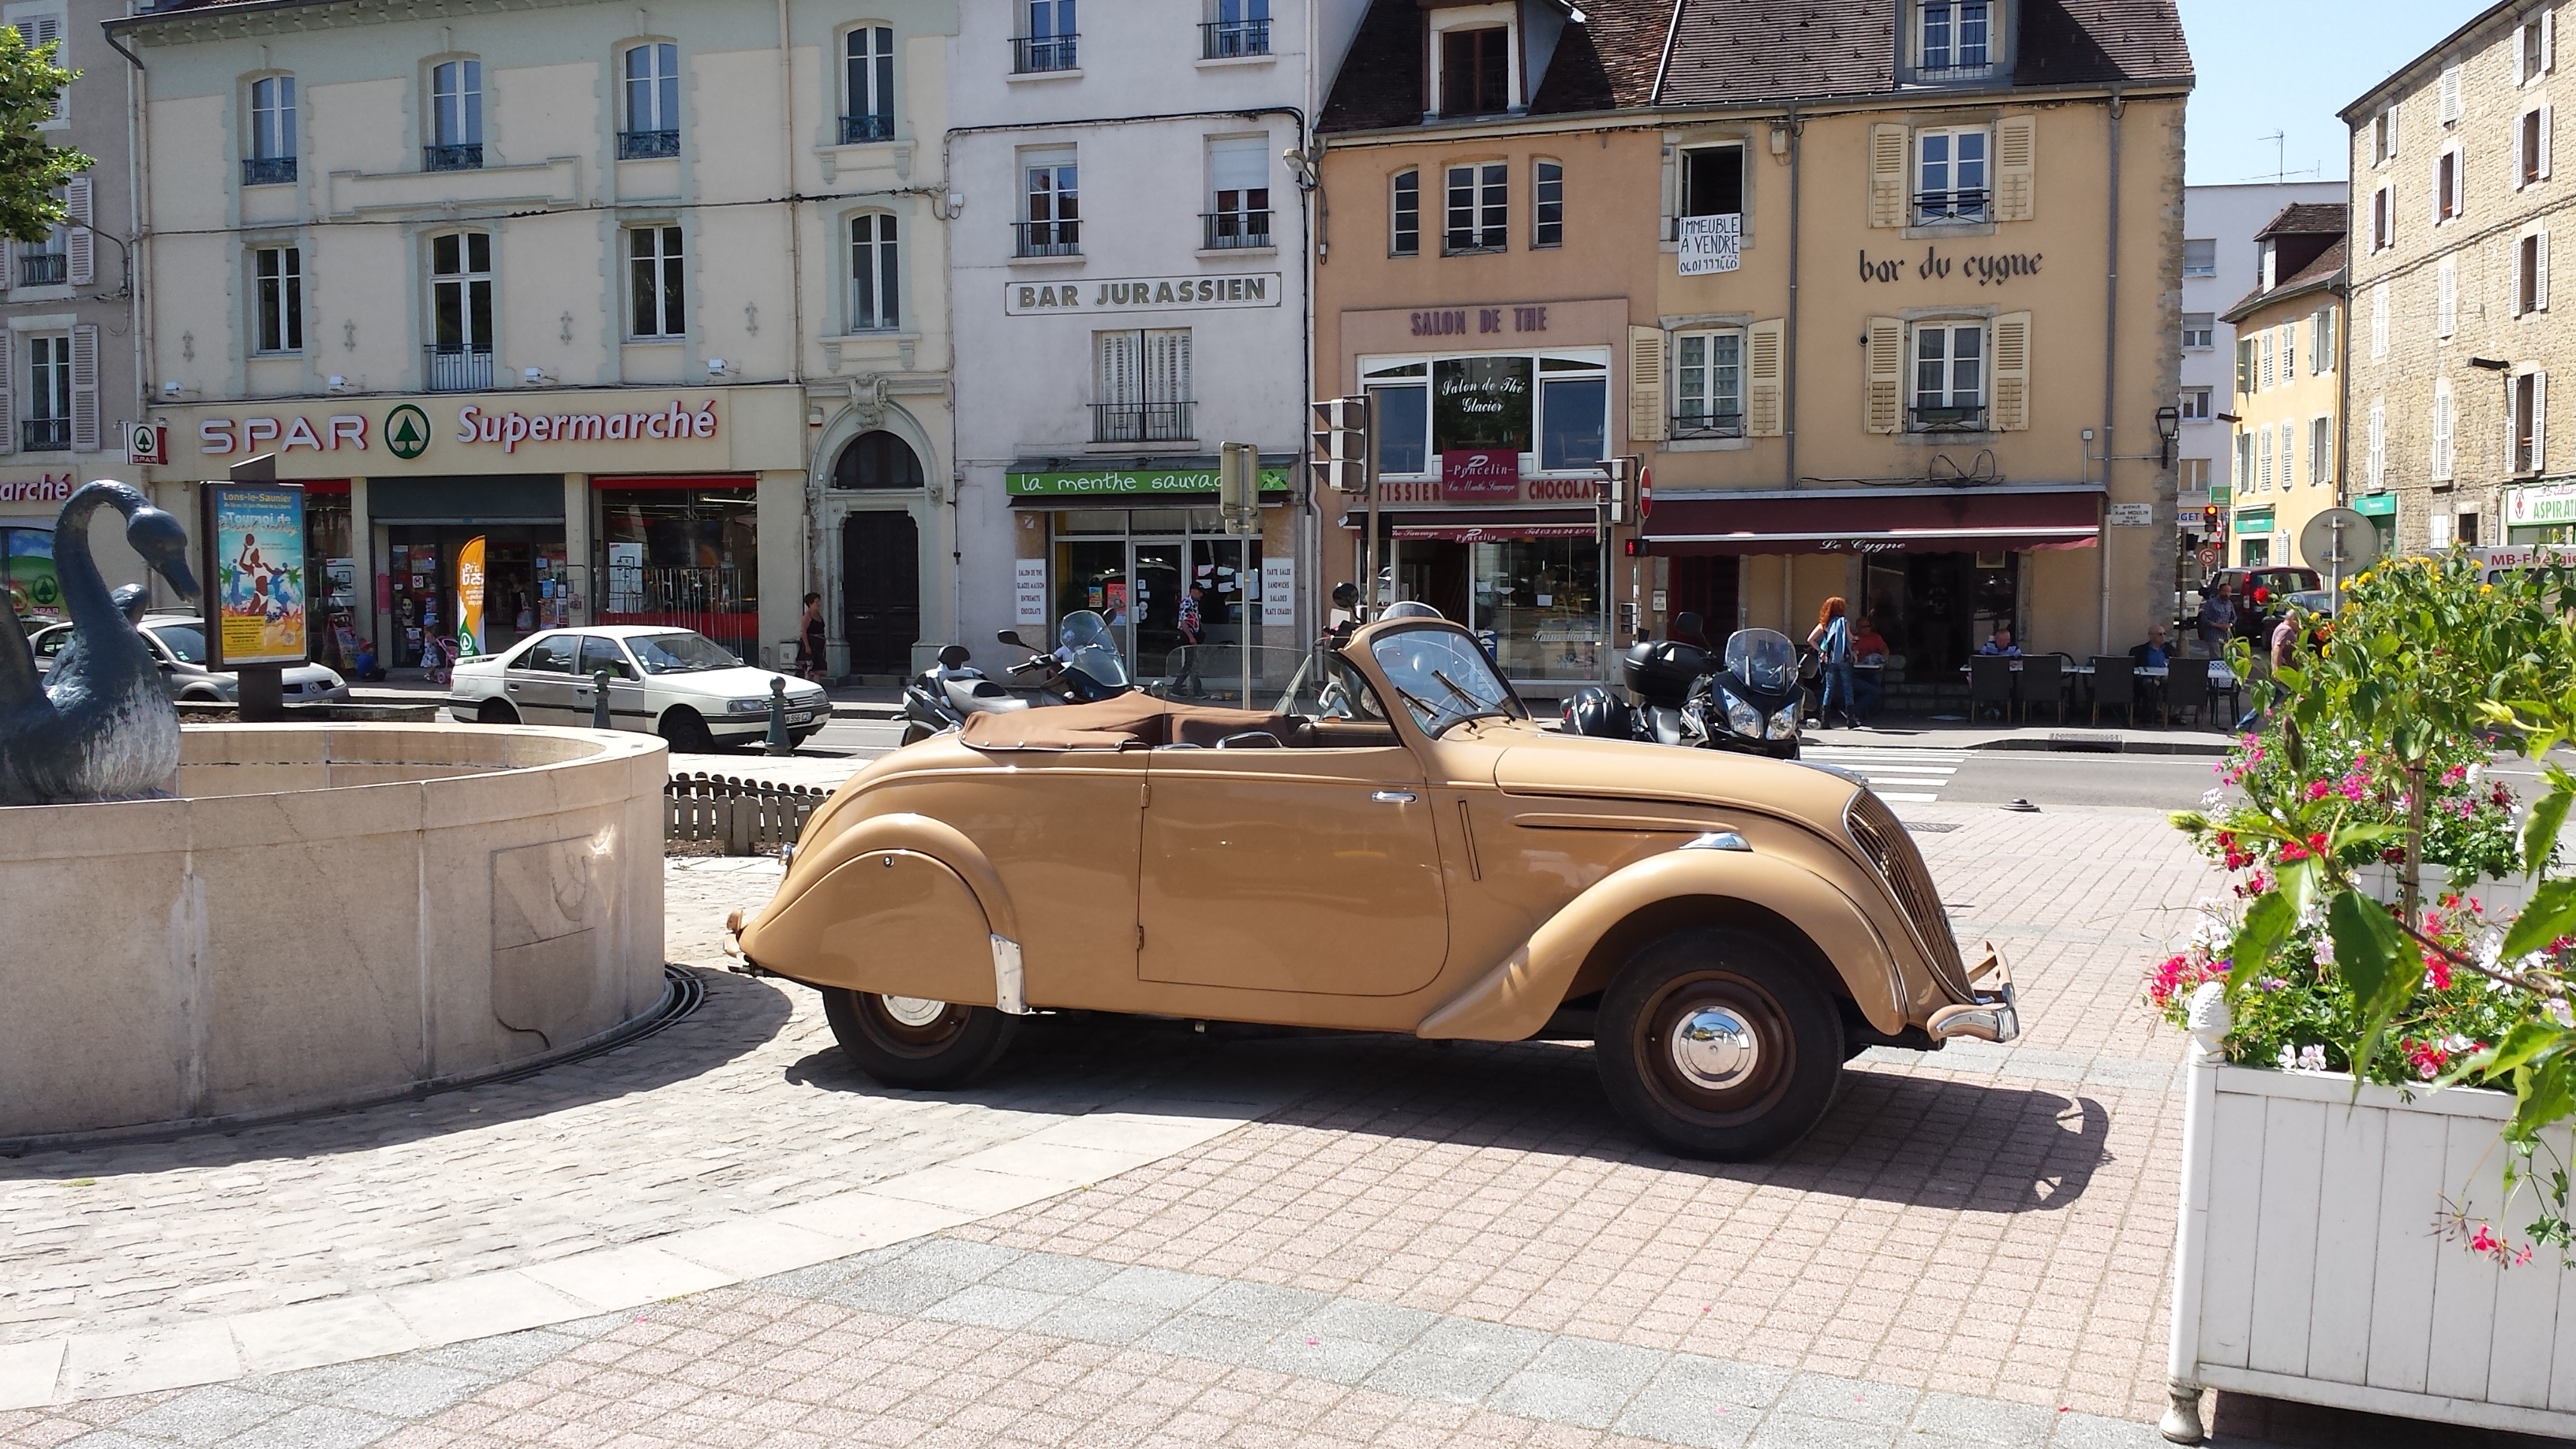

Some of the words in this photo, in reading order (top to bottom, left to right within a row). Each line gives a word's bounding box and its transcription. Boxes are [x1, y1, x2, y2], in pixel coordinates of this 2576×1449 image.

[1694, 235, 1739, 254] VENDRE
[1859, 249, 1904, 283] bar
[1919, 246, 1950, 280] du
[1964, 253, 2042, 286] cygne
[1018, 286, 1079, 309] BAR
[1095, 278, 1266, 306] JURASSIEN
[1410, 311, 1466, 336] SALON
[1480, 309, 1501, 333] DE
[1514, 307, 1547, 331] THE
[1442, 379, 1477, 396] Salon
[1481, 376, 1497, 391] de
[1500, 377, 1526, 394] Thé
[1462, 397, 1504, 413] Glacier
[199, 414, 369, 454] SPAR
[457, 400, 716, 453] Supermarché
[1022, 474, 1043, 491] la
[1058, 473, 1136, 491] menthe
[223, 492, 292, 503] Lons-le-Saunier
[226, 511, 273, 523] Tournoi
[277, 513, 291, 524] de
[1404, 529, 1440, 537] Sauvage
[1819, 540, 1842, 550] Le
[1851, 539, 1906, 553] Cygne
